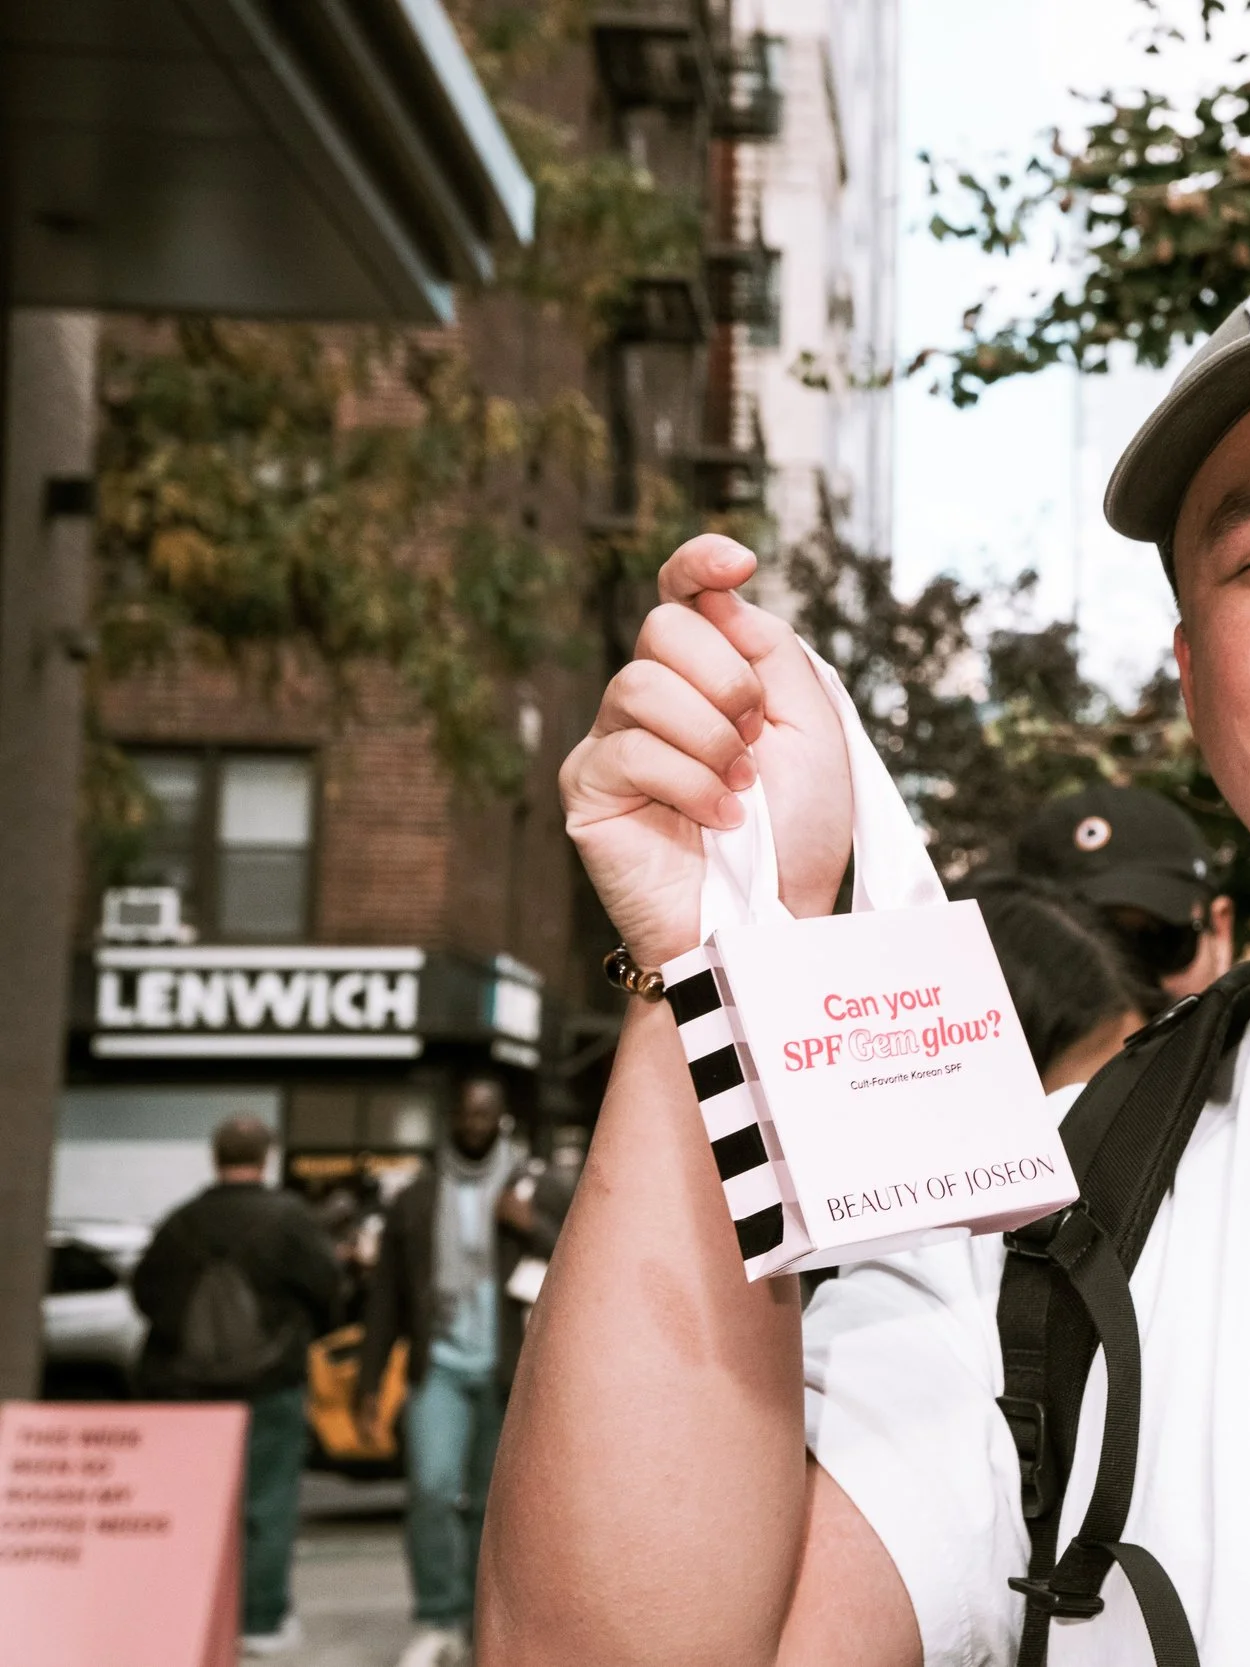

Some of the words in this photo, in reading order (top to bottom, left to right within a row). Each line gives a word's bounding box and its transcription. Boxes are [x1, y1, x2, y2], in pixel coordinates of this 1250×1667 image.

[97, 970, 419, 1029] LENWICH
[823, 991, 880, 1022] Can
[882, 984, 942, 1020] your
[783, 1033, 843, 1072] SPF
[848, 1027, 920, 1062] Gem
[921, 1009, 1002, 1057] glow?
[850, 1073, 909, 1091] Cult-Favorite
[910, 1067, 943, 1081] Korean
[944, 1062, 963, 1075] SPF
[826, 1180, 919, 1222] BEAUTY
[926, 1173, 958, 1201] OF
[964, 1154, 1055, 1197] JOSEON
